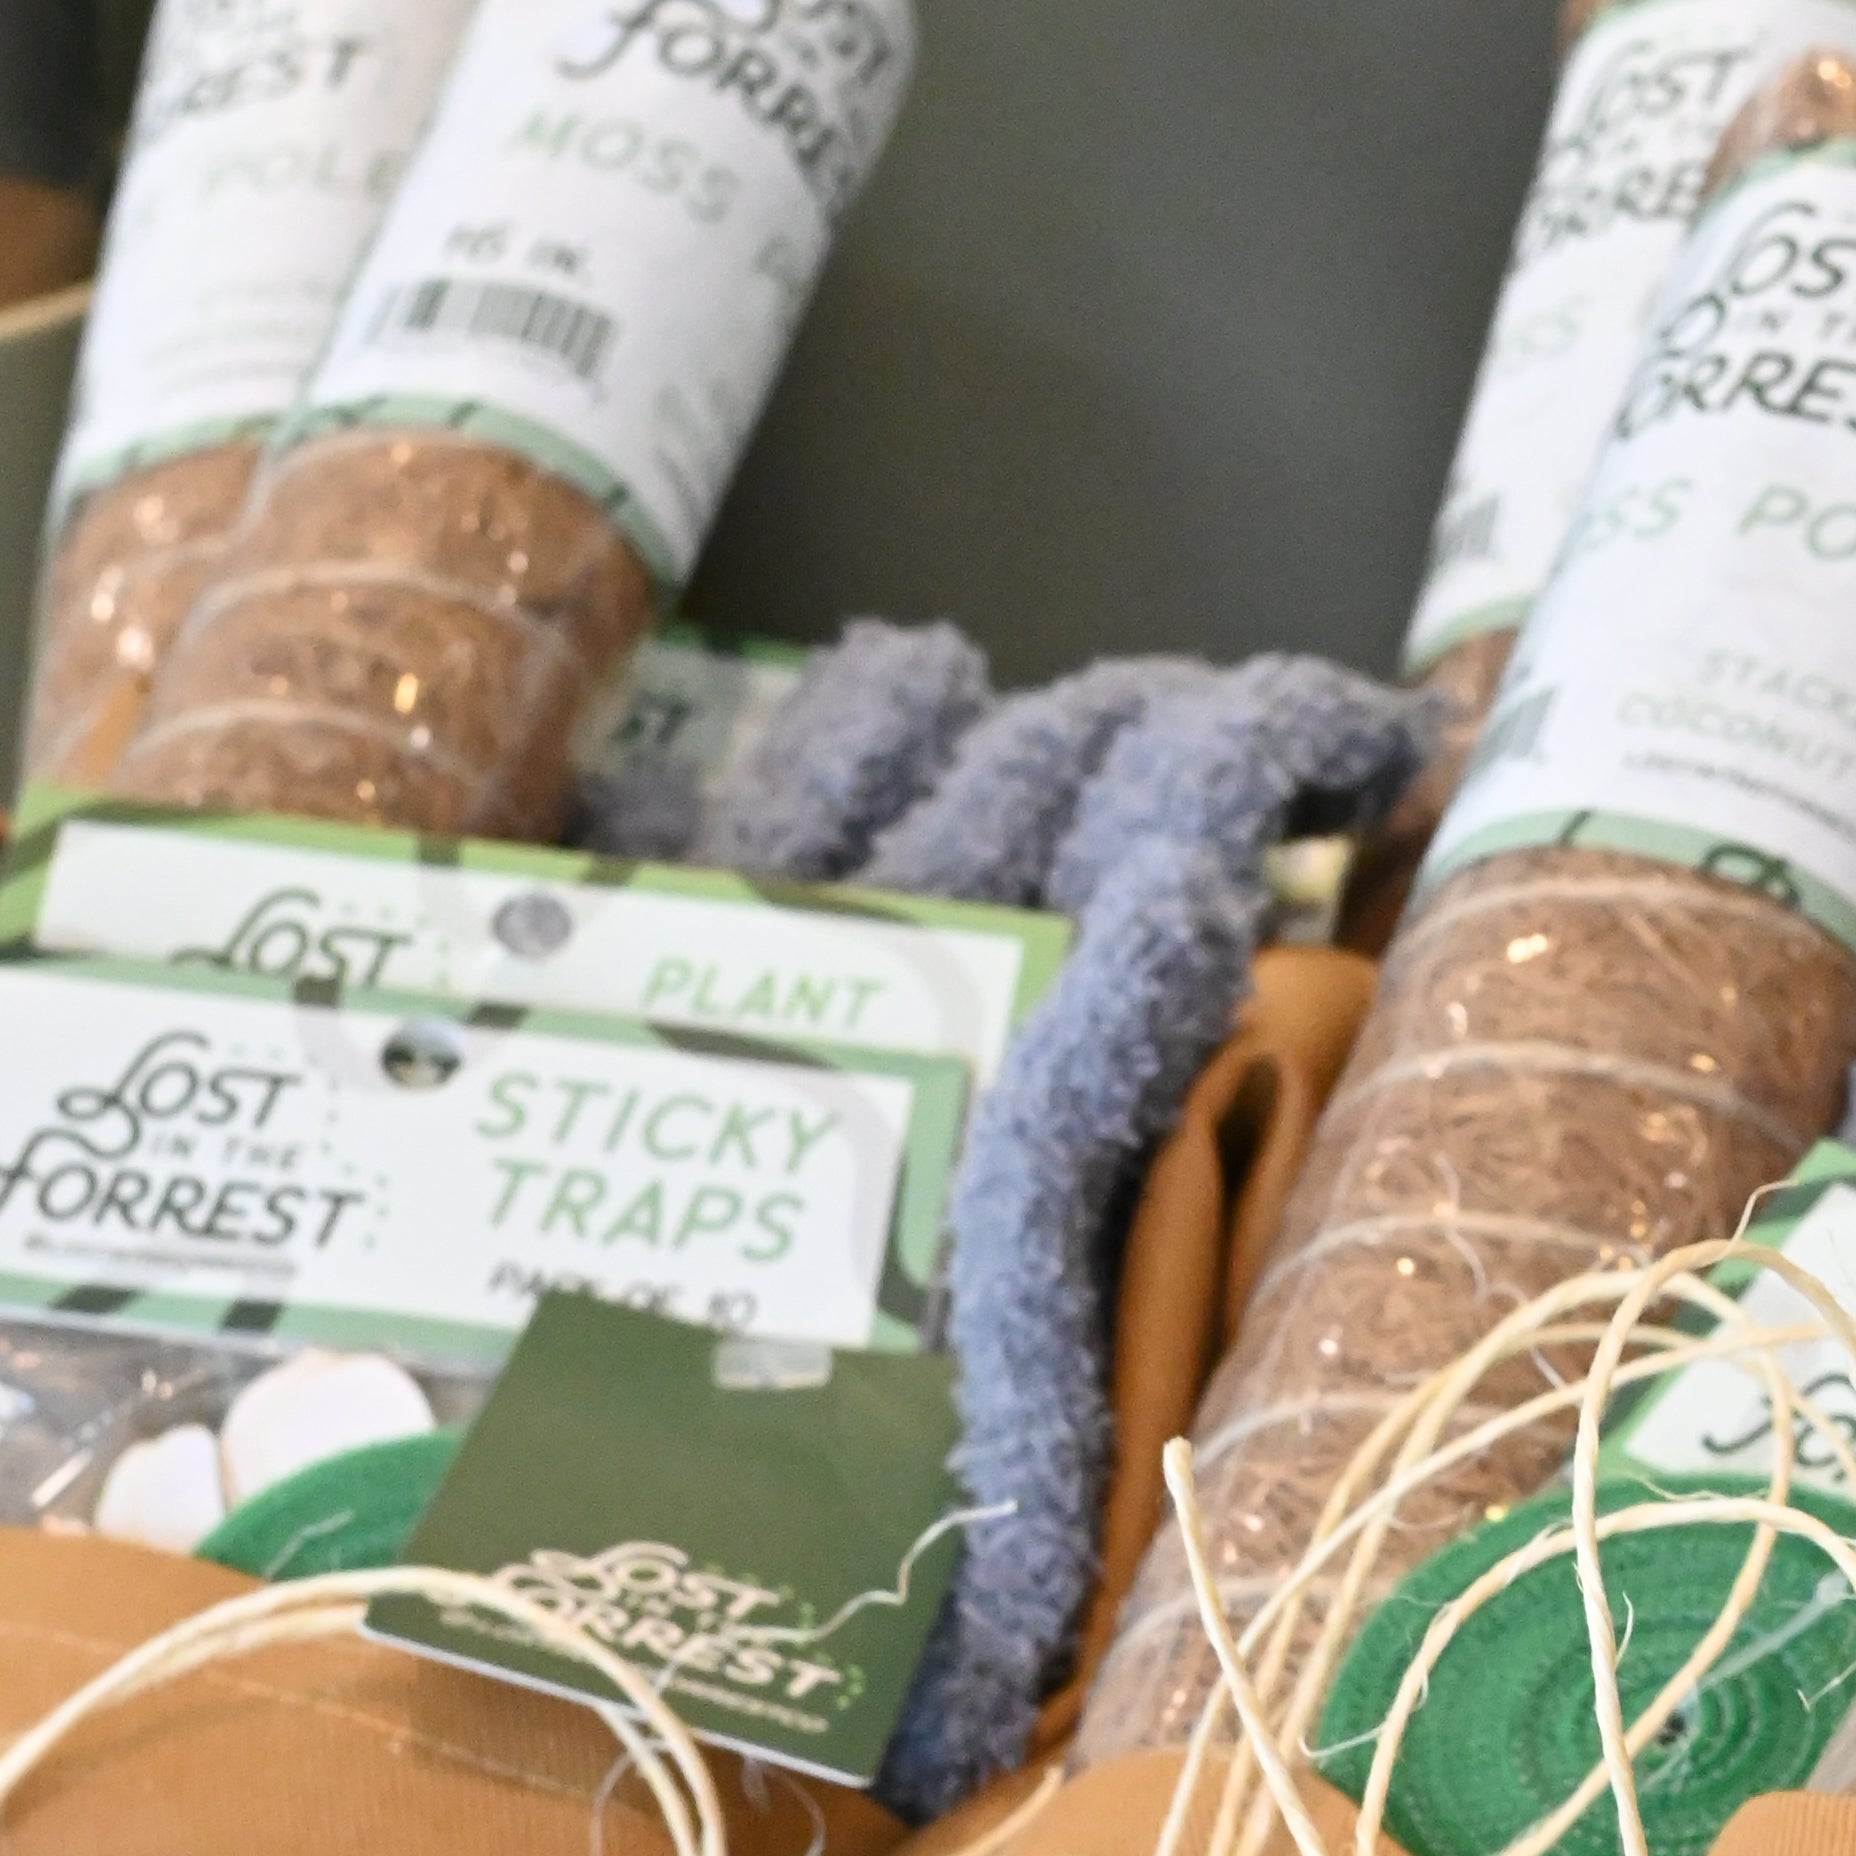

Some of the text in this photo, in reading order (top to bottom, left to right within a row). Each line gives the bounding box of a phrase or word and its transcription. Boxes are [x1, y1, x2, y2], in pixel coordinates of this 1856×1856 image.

[168, 884, 412, 992] LOST
[641, 955, 887, 1030] PLANT
[55, 1029, 305, 1161] LOST
[474, 1070, 842, 1175] STICKY
[149, 1132, 303, 1171] IN THE
[489, 1157, 807, 1263] TRAPS
